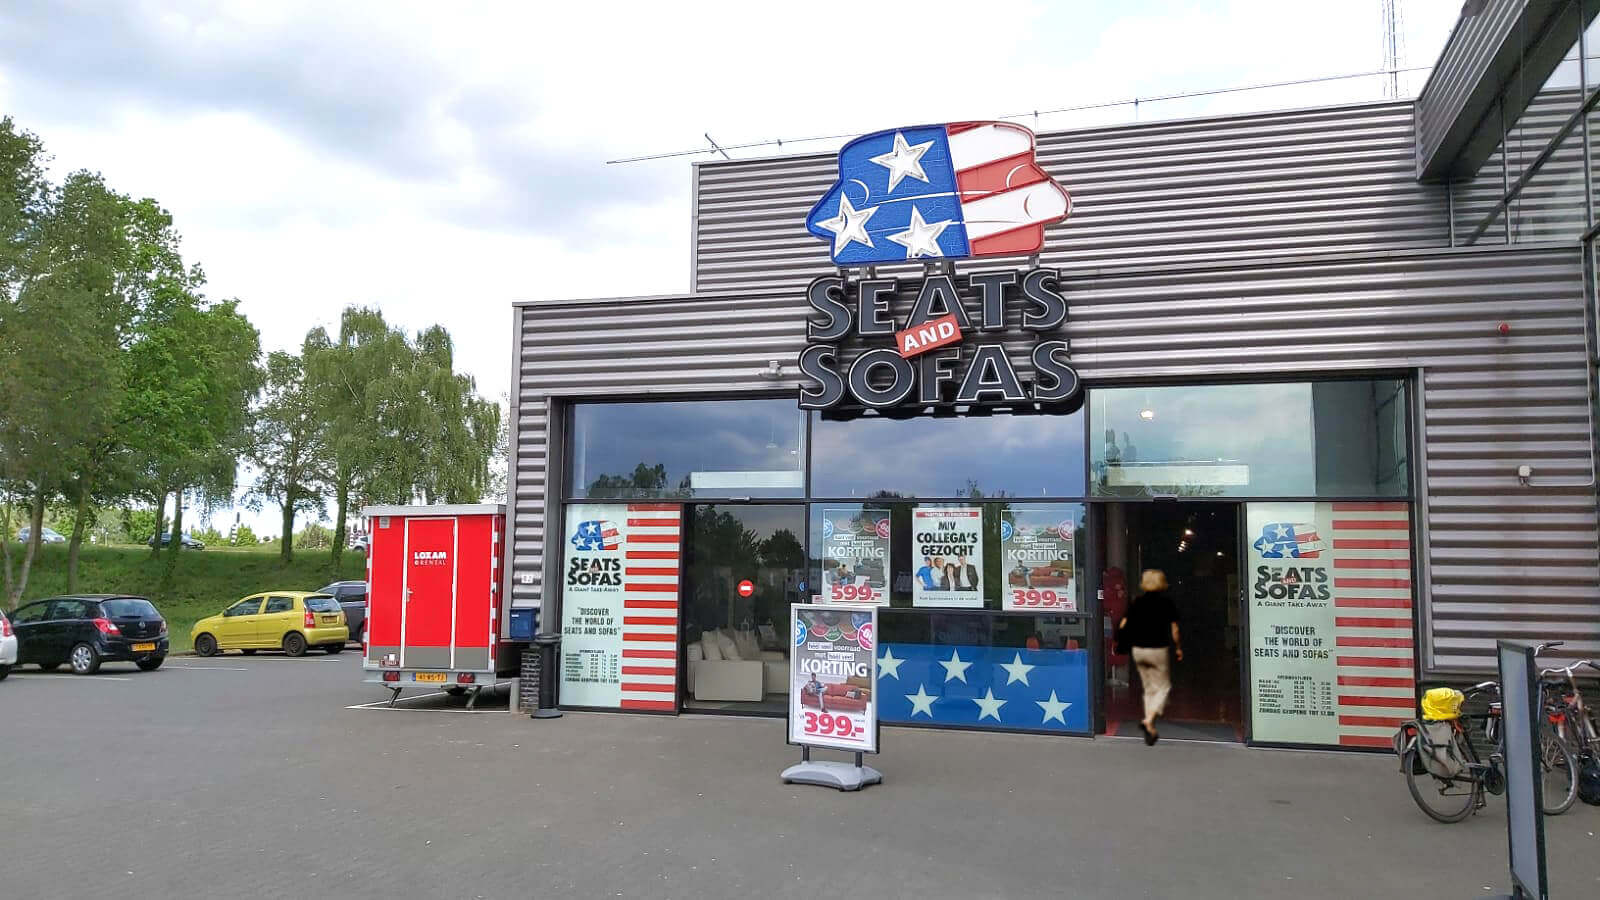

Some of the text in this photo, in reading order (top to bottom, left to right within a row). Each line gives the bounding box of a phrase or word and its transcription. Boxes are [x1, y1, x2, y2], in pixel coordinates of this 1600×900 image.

[806, 266, 1069, 342] SEATS
[903, 321, 955, 352] AND
[798, 339, 1080, 410] SOFAS
[916, 532, 978, 543] COLLEGA'S
[414, 551, 446, 560] LOXAM
[828, 546, 884, 558] KORTING
[921, 545, 974, 556] GEZOCHT
[1007, 549, 1068, 561] KORTING
[570, 557, 621, 571] SEATS
[568, 571, 622, 585] SOFAS
[1257, 565, 1328, 583] SEATS
[1254, 581, 1331, 600] SOFAS
[571, 617, 614, 626] THE WORLD OF
[564, 627, 582, 635] SEATS
[584, 627, 597, 635] AND
[1264, 637, 1323, 647] THE WORLD OF
[1254, 648, 1279, 657] SEATS
[1282, 649, 1299, 658] AND
[800, 658, 867, 677] KORTING
[804, 711, 864, 737] 399.-
